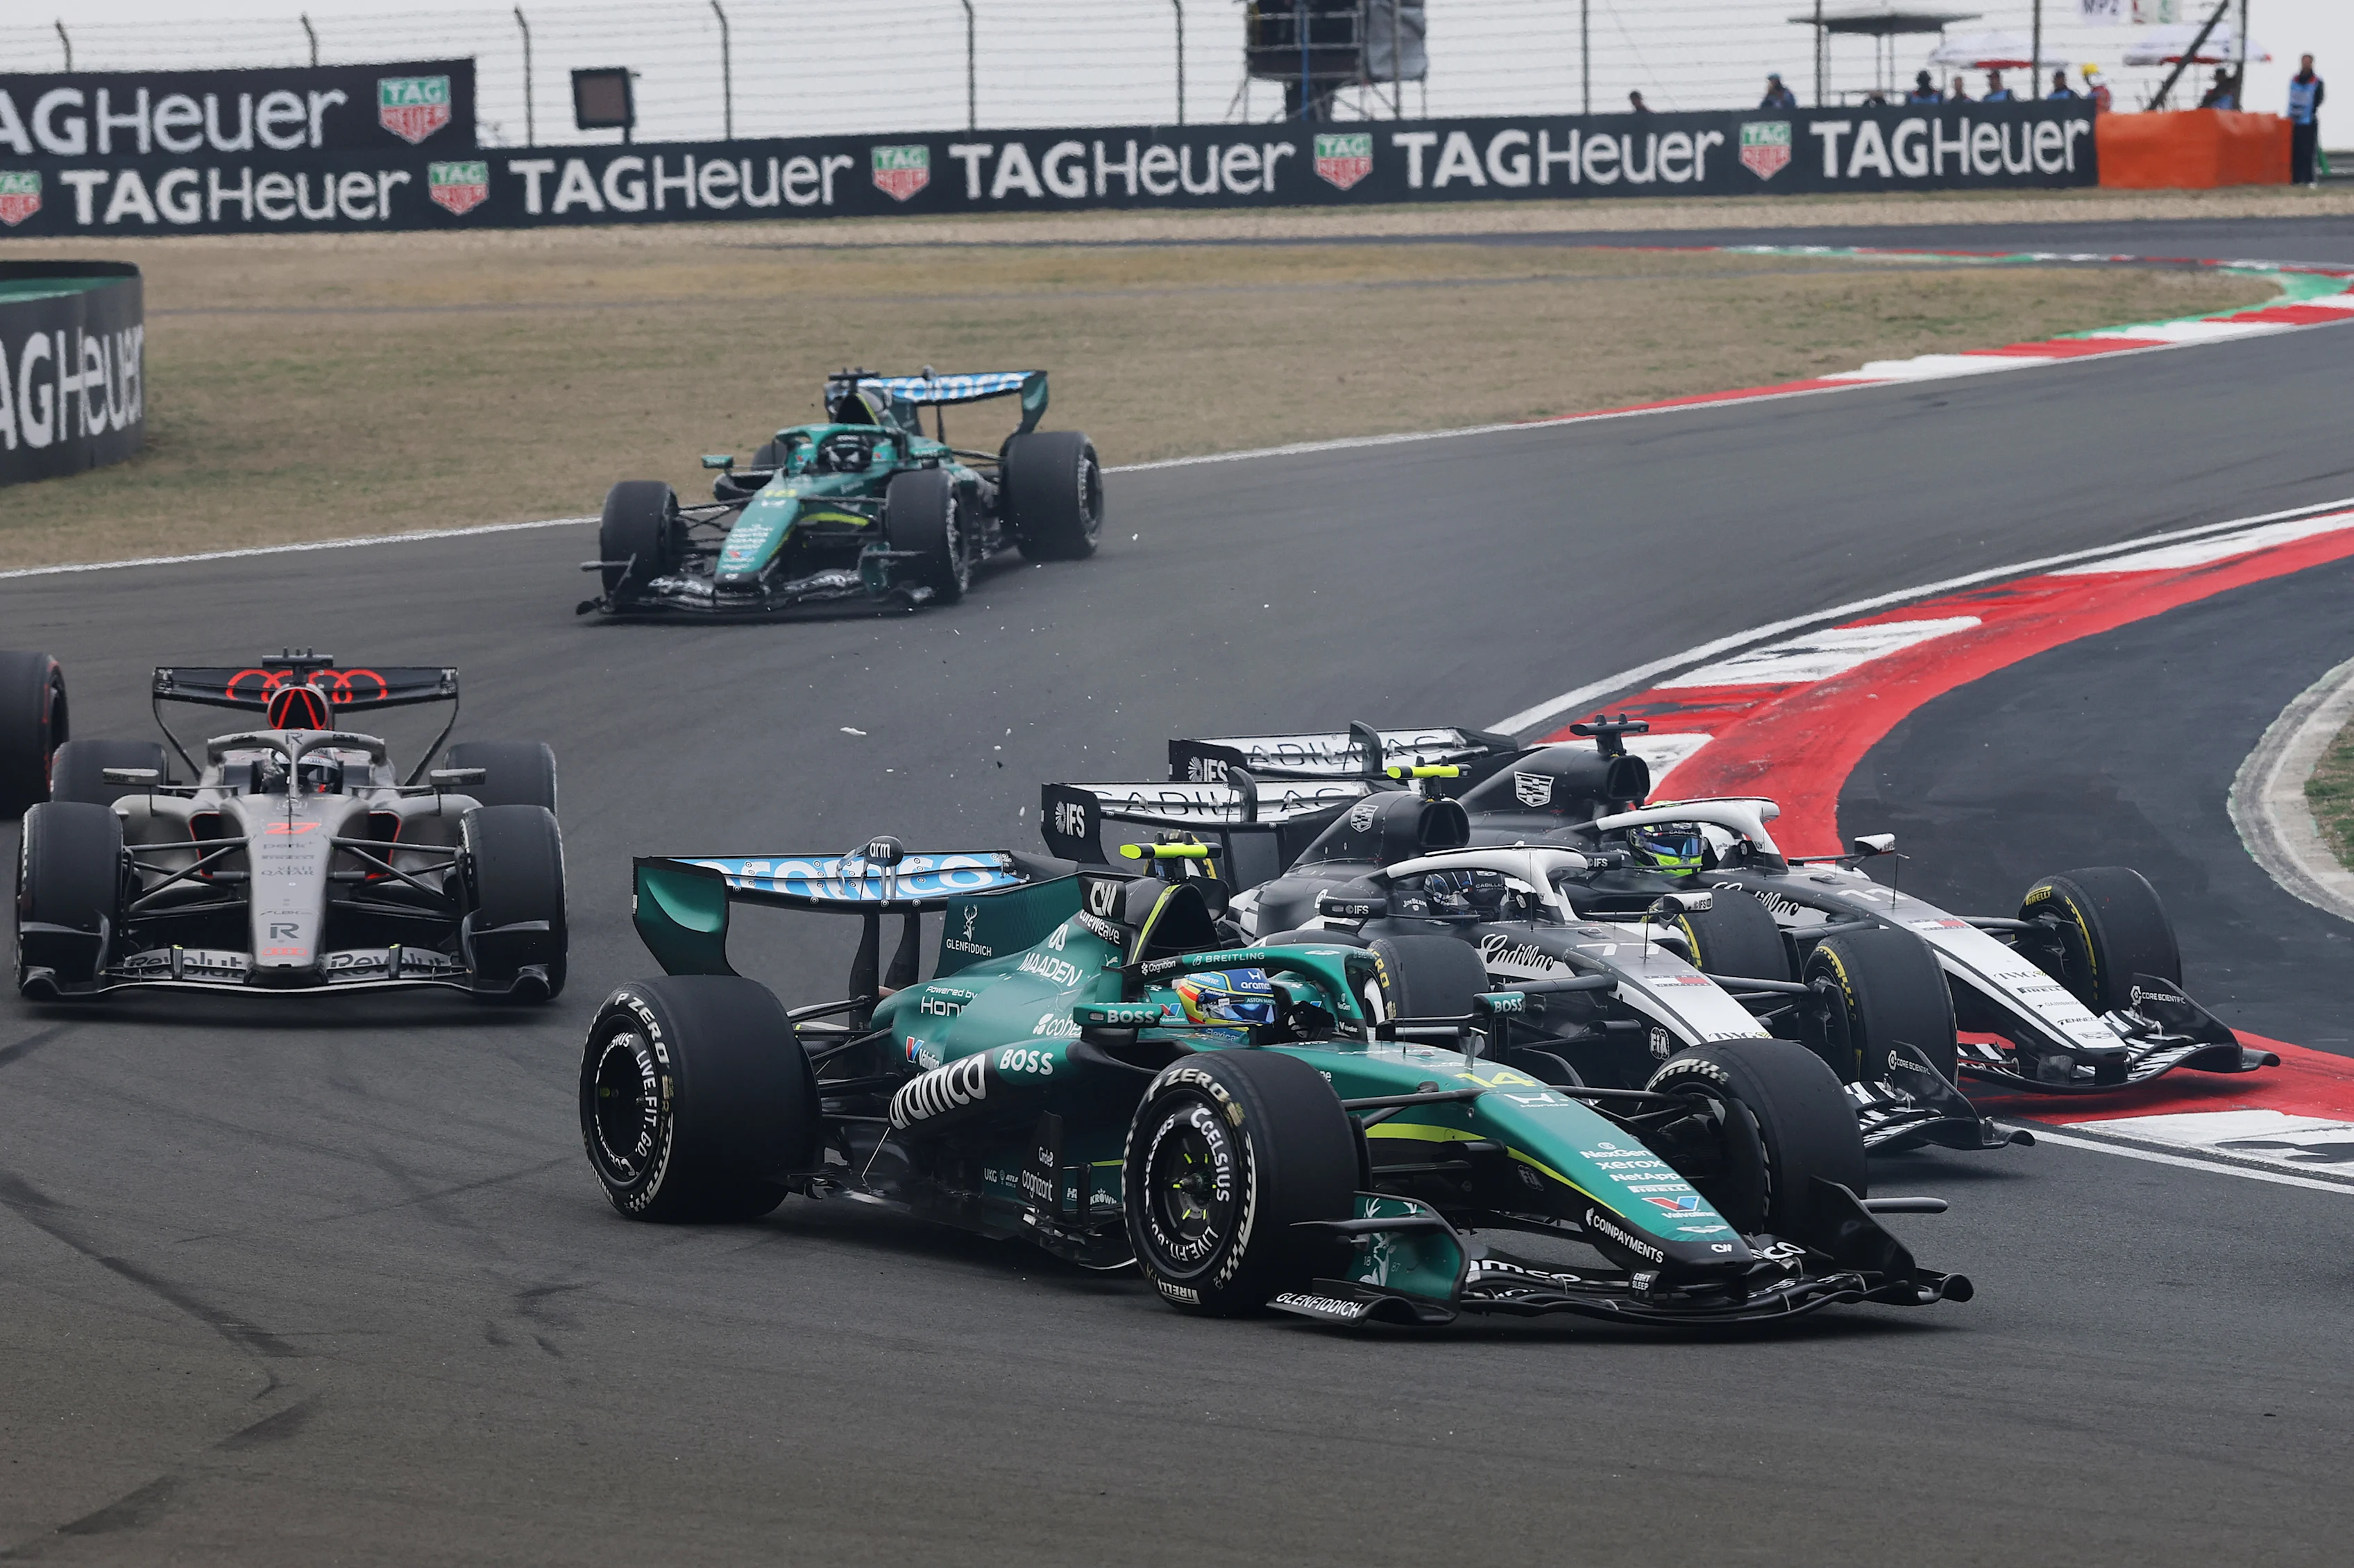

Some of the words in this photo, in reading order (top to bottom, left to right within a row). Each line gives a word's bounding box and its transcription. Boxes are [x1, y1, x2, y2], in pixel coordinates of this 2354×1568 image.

[386, 80, 443, 103] TAG
[0, 87, 348, 155] AGHeuer
[1745, 124, 1789, 144] TAG
[1319, 137, 1368, 155] TAG
[878, 150, 926, 167] TAG
[1203, 758, 1228, 783] IFS
[264, 822, 321, 835] 27
[1066, 802, 1086, 839] IFS
[870, 840, 890, 859] arm
[1593, 858, 1608, 867] IFS
[1355, 904, 1369, 915] IFS
[946, 938, 992, 957] GLENFIDDICH
[1480, 933, 1556, 971] Cadillac
[1148, 960, 1176, 973] Cognition
[1205, 952, 1265, 964] BREITLING
[925, 985, 965, 997] Powered
[965, 989, 979, 999] by
[2016, 985, 2065, 994] PIREL
[2142, 991, 2157, 1001] CORE
[920, 996, 967, 1018] Hon
[1493, 998, 1523, 1014] BOSS
[1107, 1009, 1155, 1024] BOSS
[2057, 1017, 2099, 1025] TENNEC
[614, 993, 629, 1006] P
[627, 996, 670, 1064] ZERO
[1046, 1014, 1083, 1037] cohe
[999, 1048, 1053, 1075] BOSS
[1147, 1077, 1163, 1103] P
[1164, 1068, 1230, 1103] ZERO
[1454, 1071, 1537, 1088] 14
[889, 1053, 987, 1130] aramco
[1201, 1120, 1231, 1202] CELSIUS
[1580, 1149, 1653, 1159] NexGen
[1595, 1159, 1668, 1170] xerox
[983, 1168, 997, 1183] UKG
[1609, 1173, 1682, 1182] NetApp
[1022, 1169, 1053, 1202] cognizant
[1627, 1184, 1692, 1193] PIRELLI
[1593, 1215, 1664, 1263] COINPAYMENTS
[1363, 1255, 1371, 1266] 18
[1391, 1261, 1401, 1272] 87
[1633, 1272, 1652, 1281] EIGHT
[1158, 1278, 1201, 1305] PIRELLI
[1632, 1281, 1650, 1290] SLEEP
[1276, 1293, 1364, 1318] GLENFIDDICH
